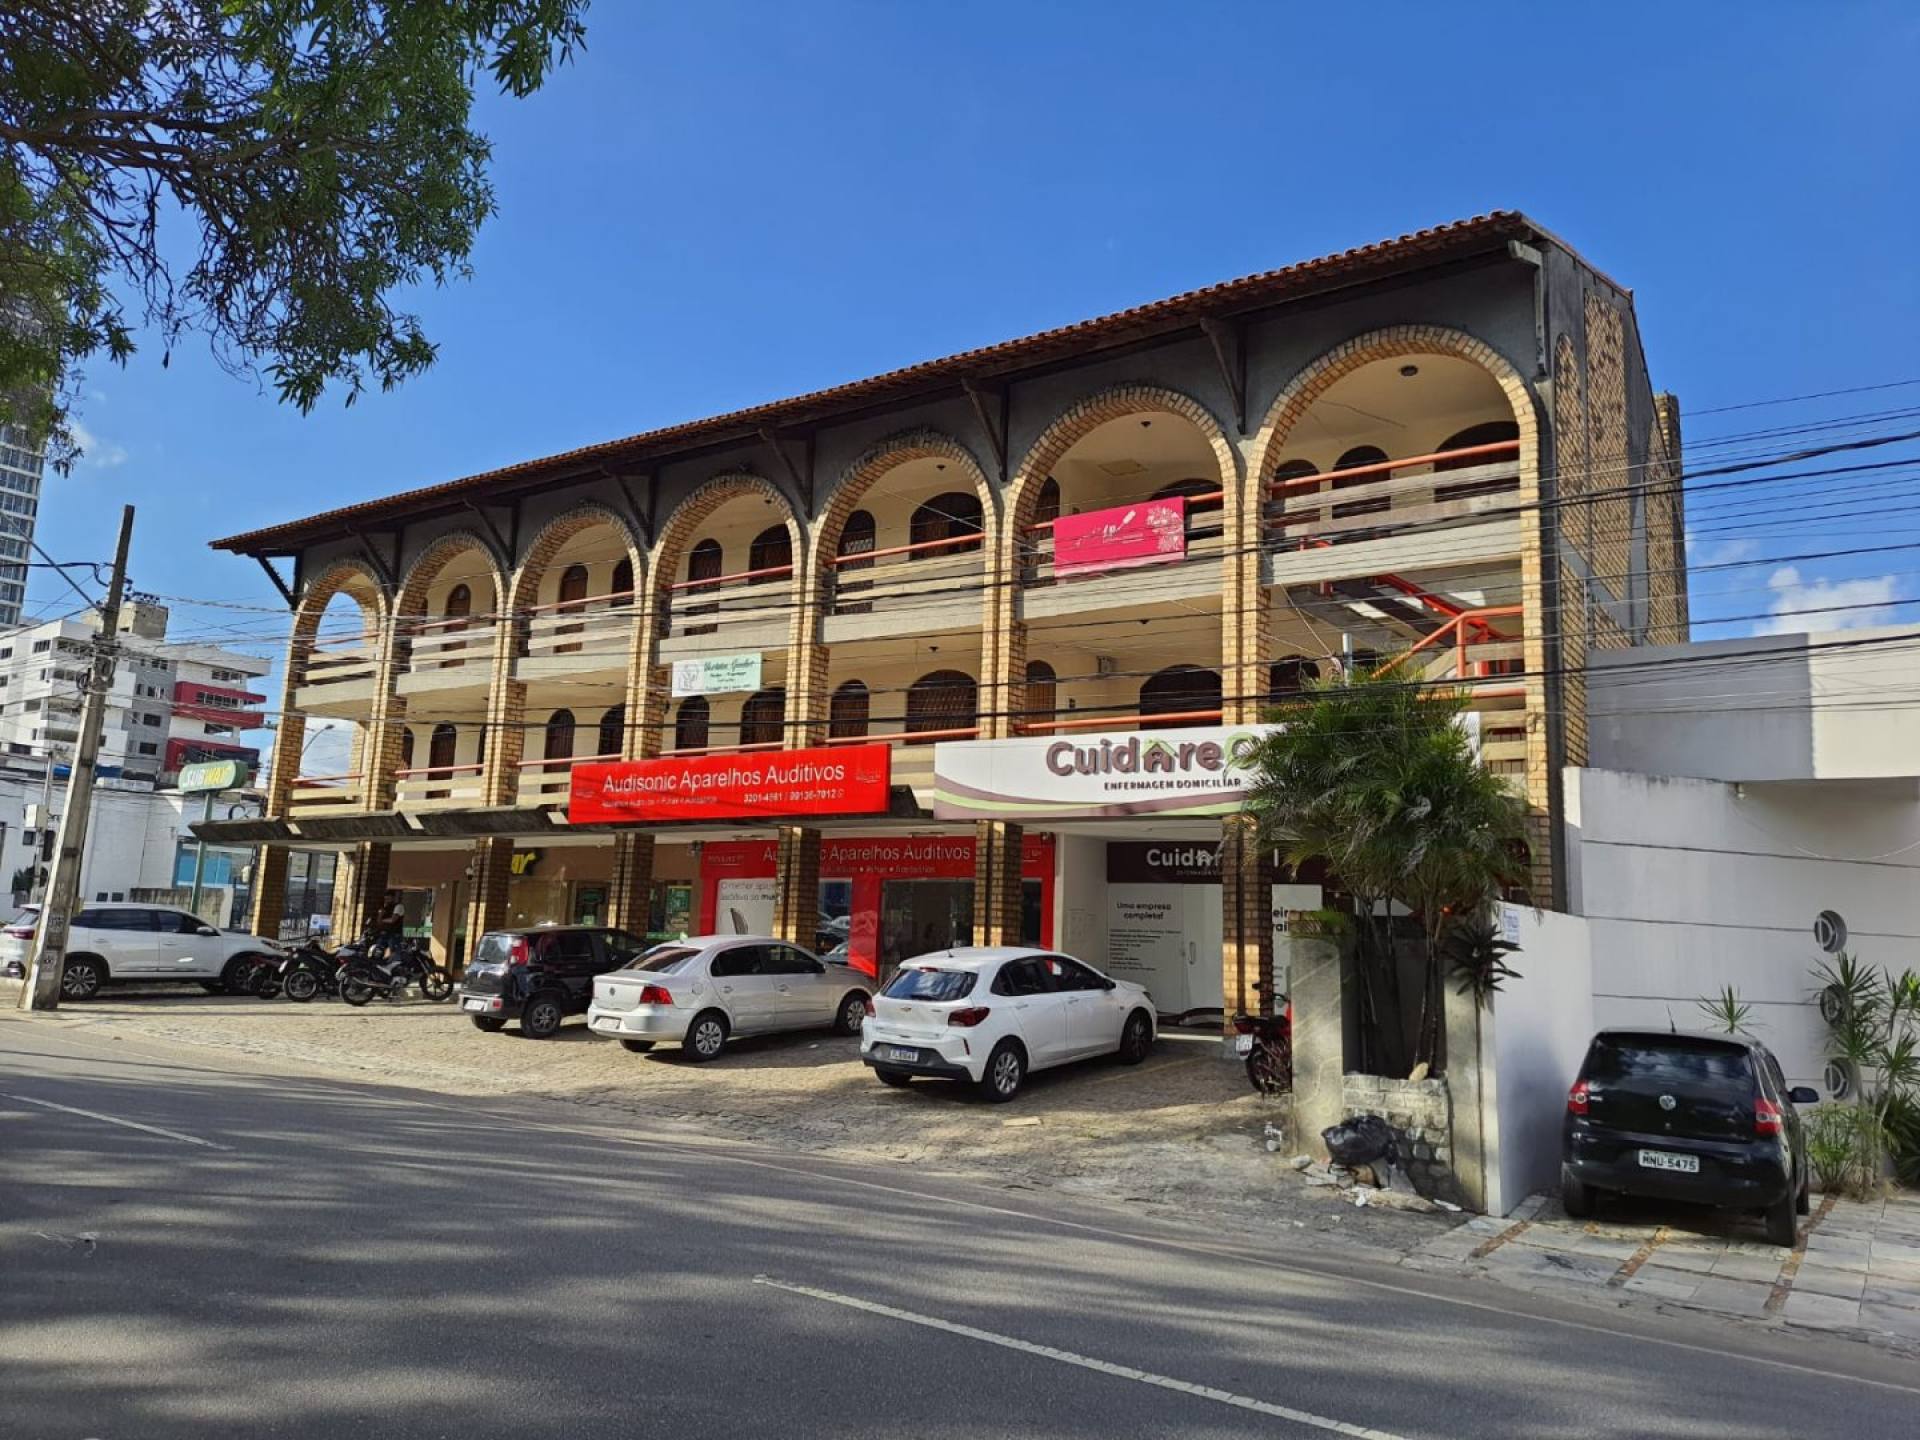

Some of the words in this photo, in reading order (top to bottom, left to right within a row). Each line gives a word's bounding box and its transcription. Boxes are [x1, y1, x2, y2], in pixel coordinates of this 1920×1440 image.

[603, 773, 677, 793] Audisonic
[680, 767, 761, 793] Aparelhos
[765, 762, 845, 785] Auditivos
[1104, 780, 1174, 791] ENFERMAGEM
[1176, 778, 1241, 790] DOMICILIAR
[830, 843, 900, 864] Aparelhos
[903, 842, 970, 860] Auditivos
